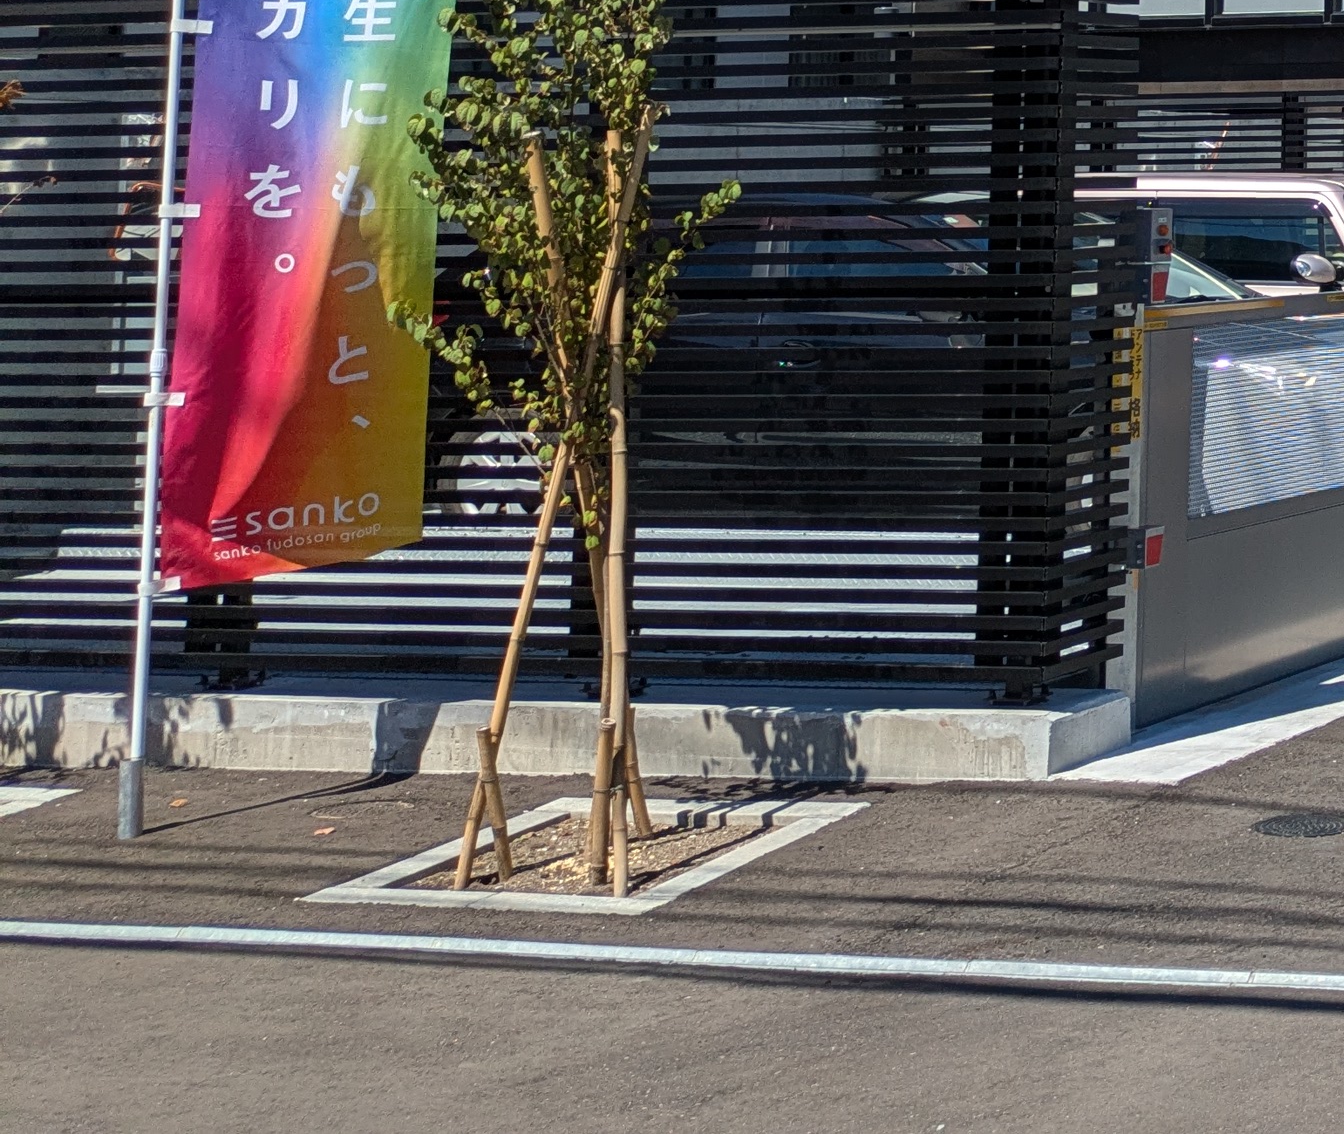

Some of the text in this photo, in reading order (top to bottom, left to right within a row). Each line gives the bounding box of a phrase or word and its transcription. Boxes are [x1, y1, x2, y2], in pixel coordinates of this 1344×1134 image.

[245, 492, 380, 536] sanko
[213, 522, 382, 561] sanko fudosan group
